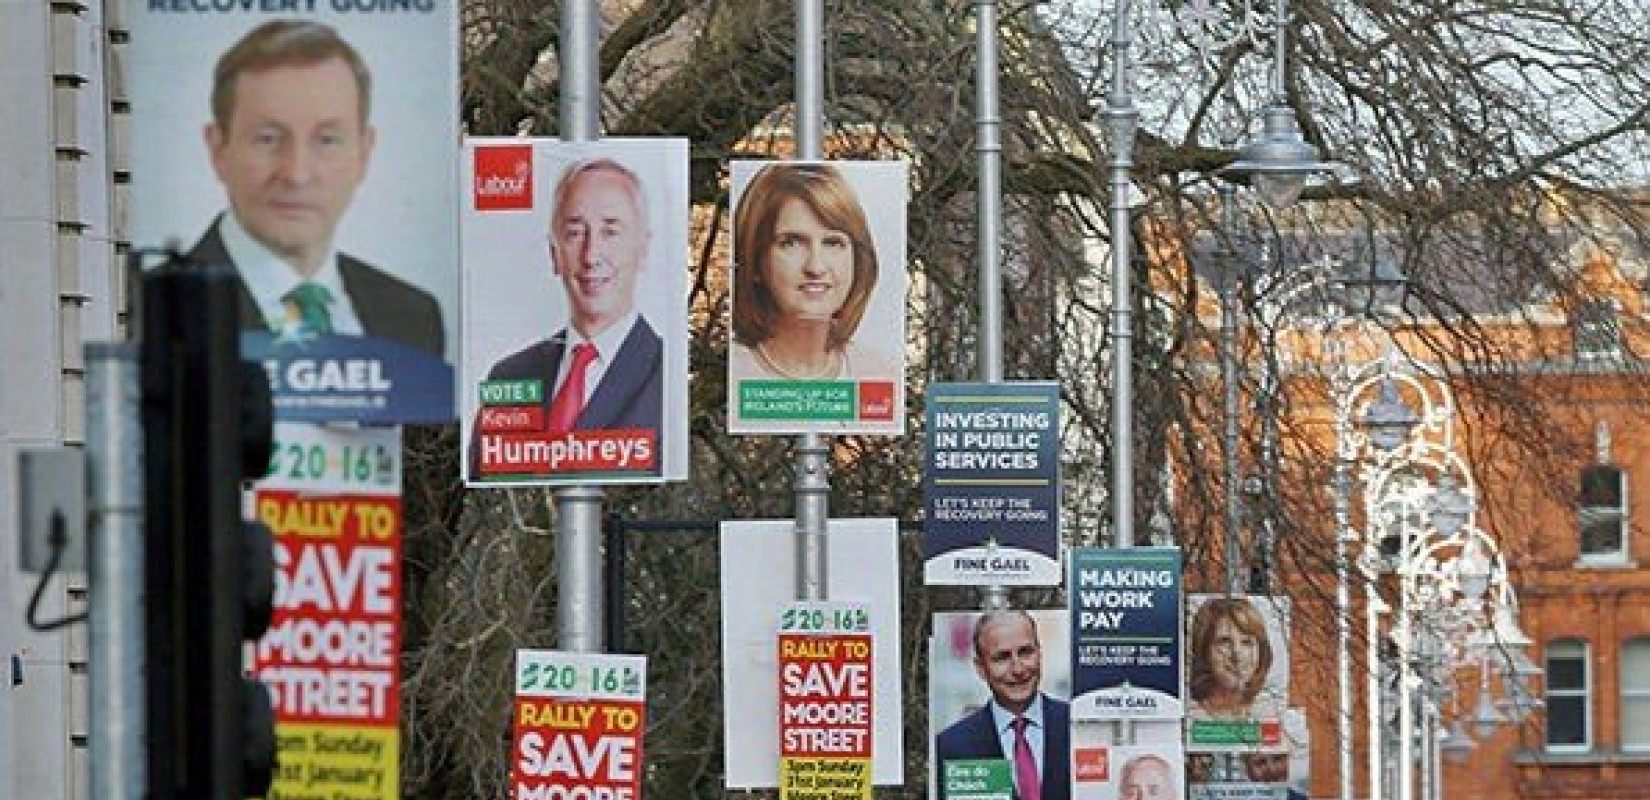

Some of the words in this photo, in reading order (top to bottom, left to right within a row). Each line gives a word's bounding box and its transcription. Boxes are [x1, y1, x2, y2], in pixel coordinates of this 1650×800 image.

[287, 359, 392, 391] GAEL
[482, 384, 522, 398] VOTE
[528, 384, 537, 398] 1
[482, 409, 529, 428] Kevin
[936, 412, 1049, 428] INVESTING
[936, 431, 958, 447] IN
[964, 431, 1040, 449] PUBLIC
[482, 434, 651, 469] Humphreys
[935, 451, 1038, 469] SERVICES
[355, 504, 393, 540] TO
[954, 558, 987, 571] FINE
[989, 558, 1030, 571] GAEL
[1080, 570, 1174, 587] MAKING
[1080, 590, 1155, 608] WORK
[1080, 611, 1124, 629] PAY
[782, 639, 838, 658] RALLY
[843, 640, 869, 658] TO
[783, 662, 869, 697] SAVE
[520, 702, 597, 729] RALLY
[602, 706, 639, 732] TO
[783, 701, 869, 724] MOORE
[314, 732, 383, 762] Sunday
[783, 728, 869, 752] STREET
[519, 732, 636, 780] SAVE
[304, 762, 382, 788] January
[817, 760, 863, 776] Sunday
[518, 781, 635, 800] MOORE
[814, 776, 863, 790] January
